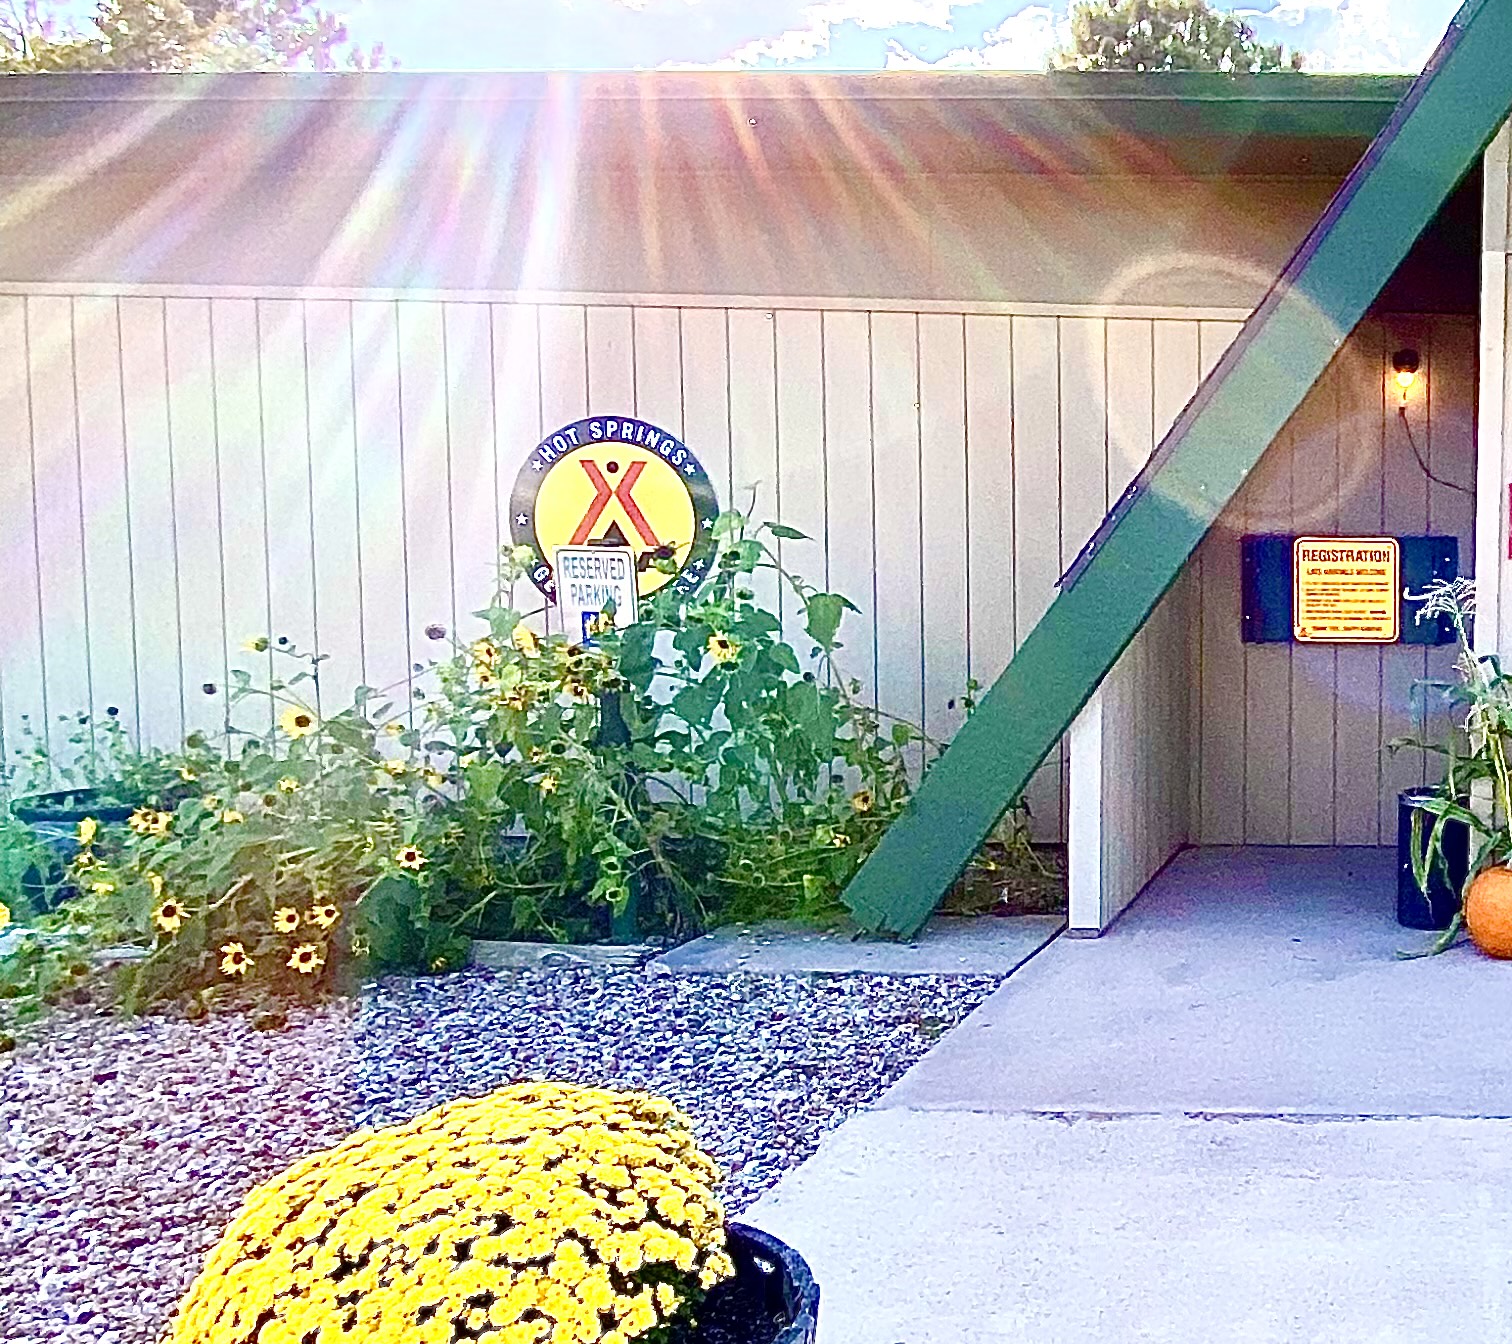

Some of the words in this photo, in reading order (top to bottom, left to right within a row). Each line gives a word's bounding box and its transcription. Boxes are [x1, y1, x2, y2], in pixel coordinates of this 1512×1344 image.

[538, 427, 578, 463] HOT
[589, 420, 688, 466] SPRINGS
[563, 556, 625, 580] RESERVED
[1302, 549, 1390, 563] REGISTRATION
[570, 583, 622, 607] PARKING
